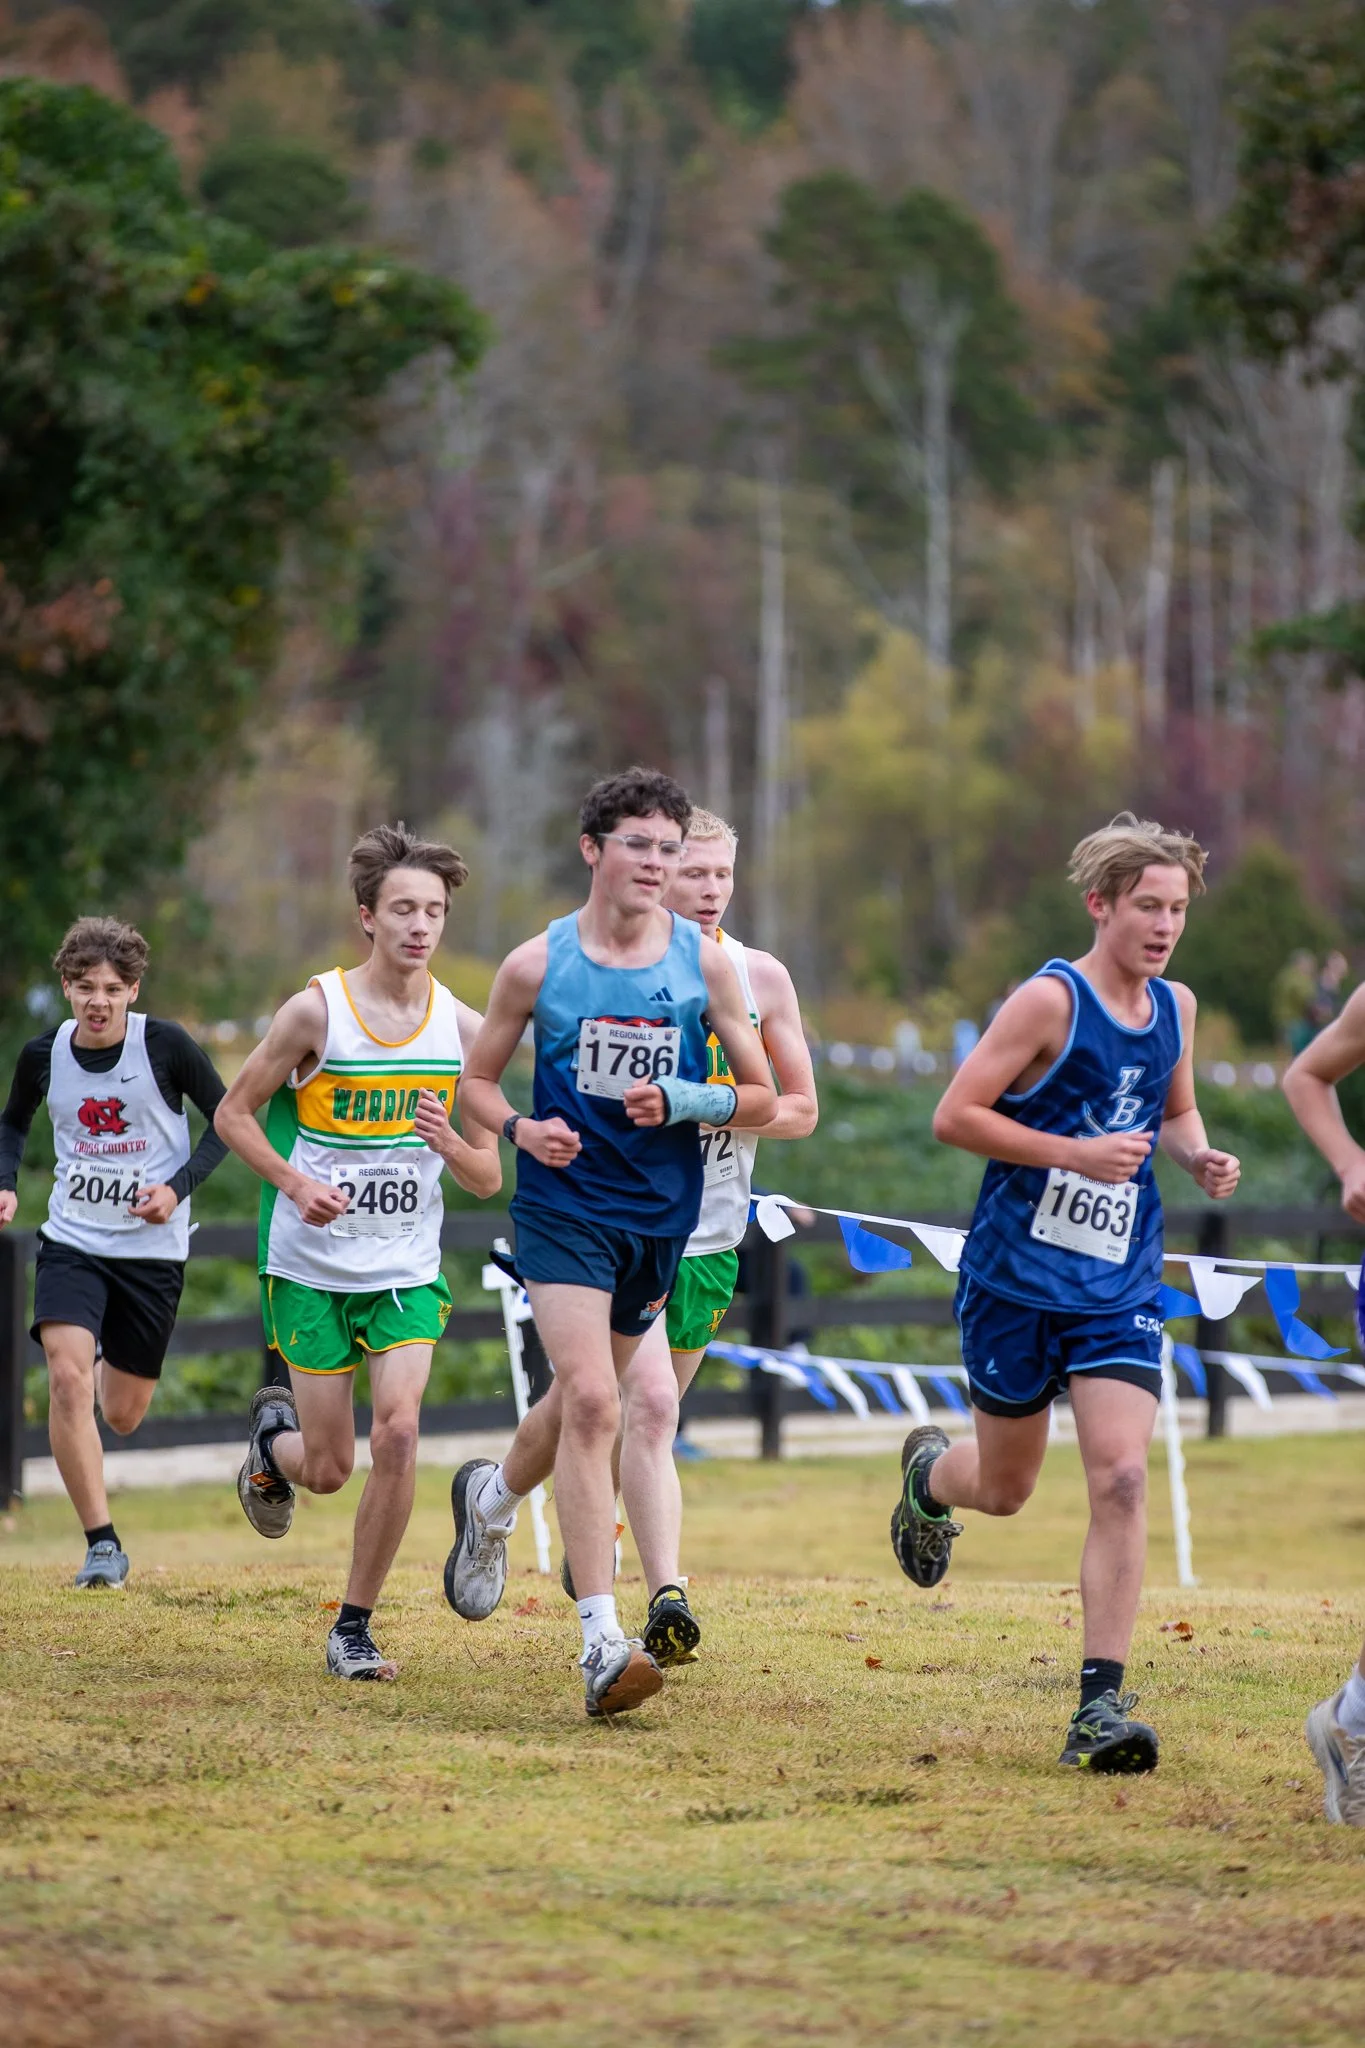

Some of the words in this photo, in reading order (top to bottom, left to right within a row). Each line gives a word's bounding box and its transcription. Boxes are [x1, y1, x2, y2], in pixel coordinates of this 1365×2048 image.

[609, 1028, 654, 1041] REGIONALS
[585, 1039, 674, 1081] 1786
[332, 1087, 448, 1122] WARRIOS
[73, 1140, 100, 1156] CROSS
[102, 1139, 147, 1155] COUNTRY
[89, 1164, 124, 1176] REGIONALS
[358, 1168, 399, 1177] REGIONALS
[68, 1174, 141, 1208] 2044
[337, 1179, 418, 1215] 2468
[1050, 1181, 1131, 1237] 1663
